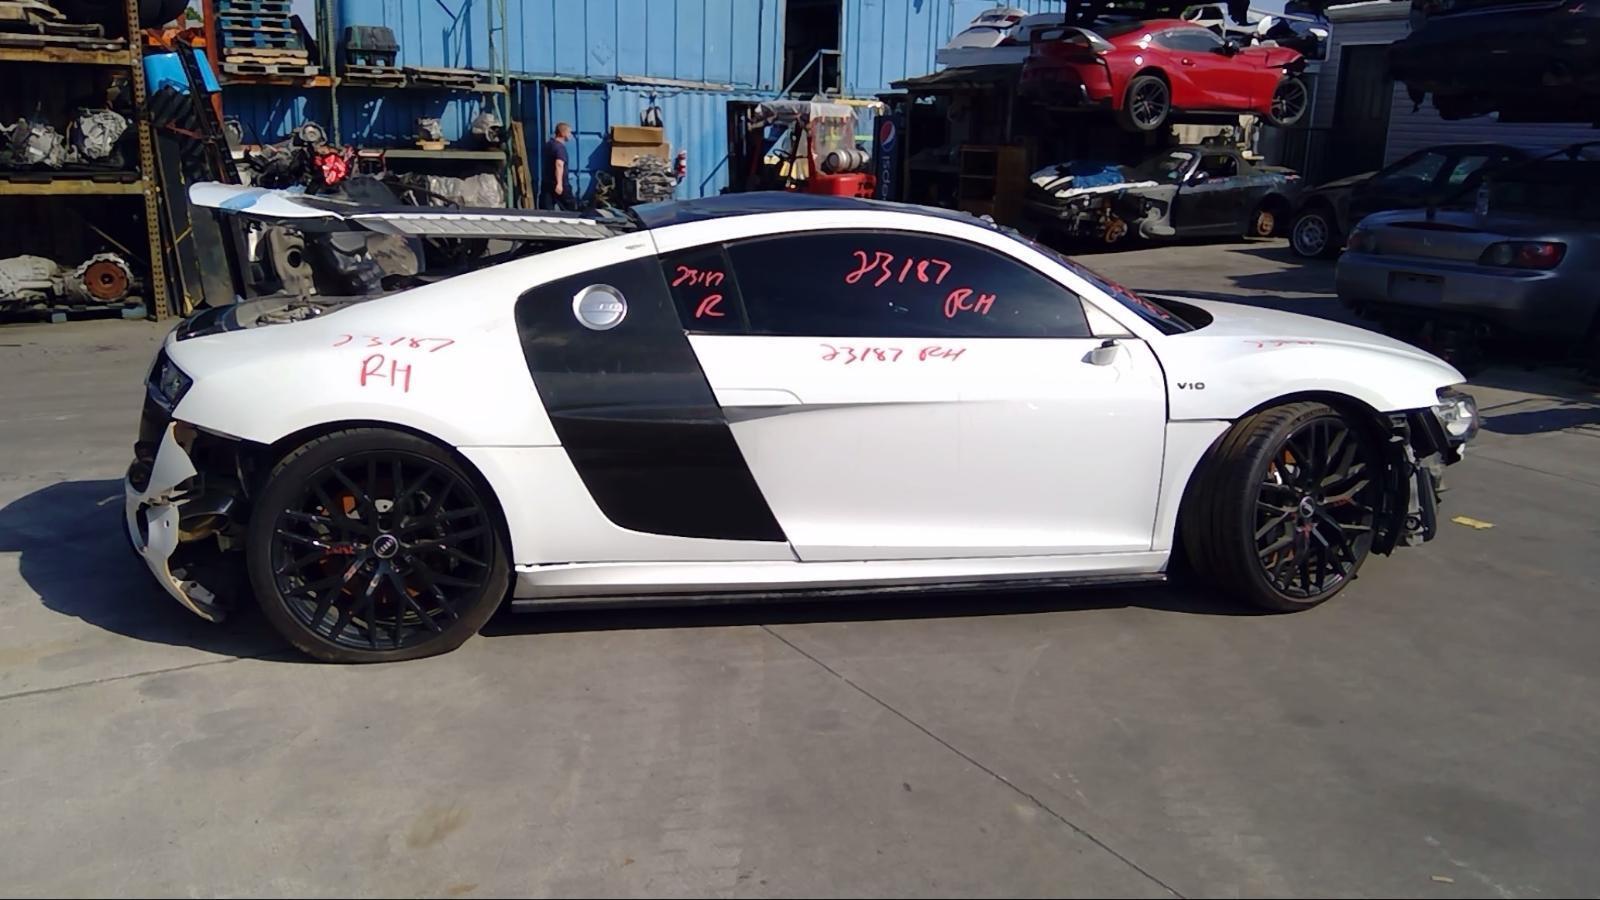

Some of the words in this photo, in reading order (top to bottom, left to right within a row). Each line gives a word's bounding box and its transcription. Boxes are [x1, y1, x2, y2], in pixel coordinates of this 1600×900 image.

[881, 156, 891, 201] epsi
[845, 250, 952, 287] 23187
[695, 294, 726, 318] R
[945, 288, 997, 318] RH
[332, 334, 456, 353] 23187
[820, 343, 904, 365] 23187
[360, 353, 412, 393] RH
[1176, 381, 1206, 391] V10
